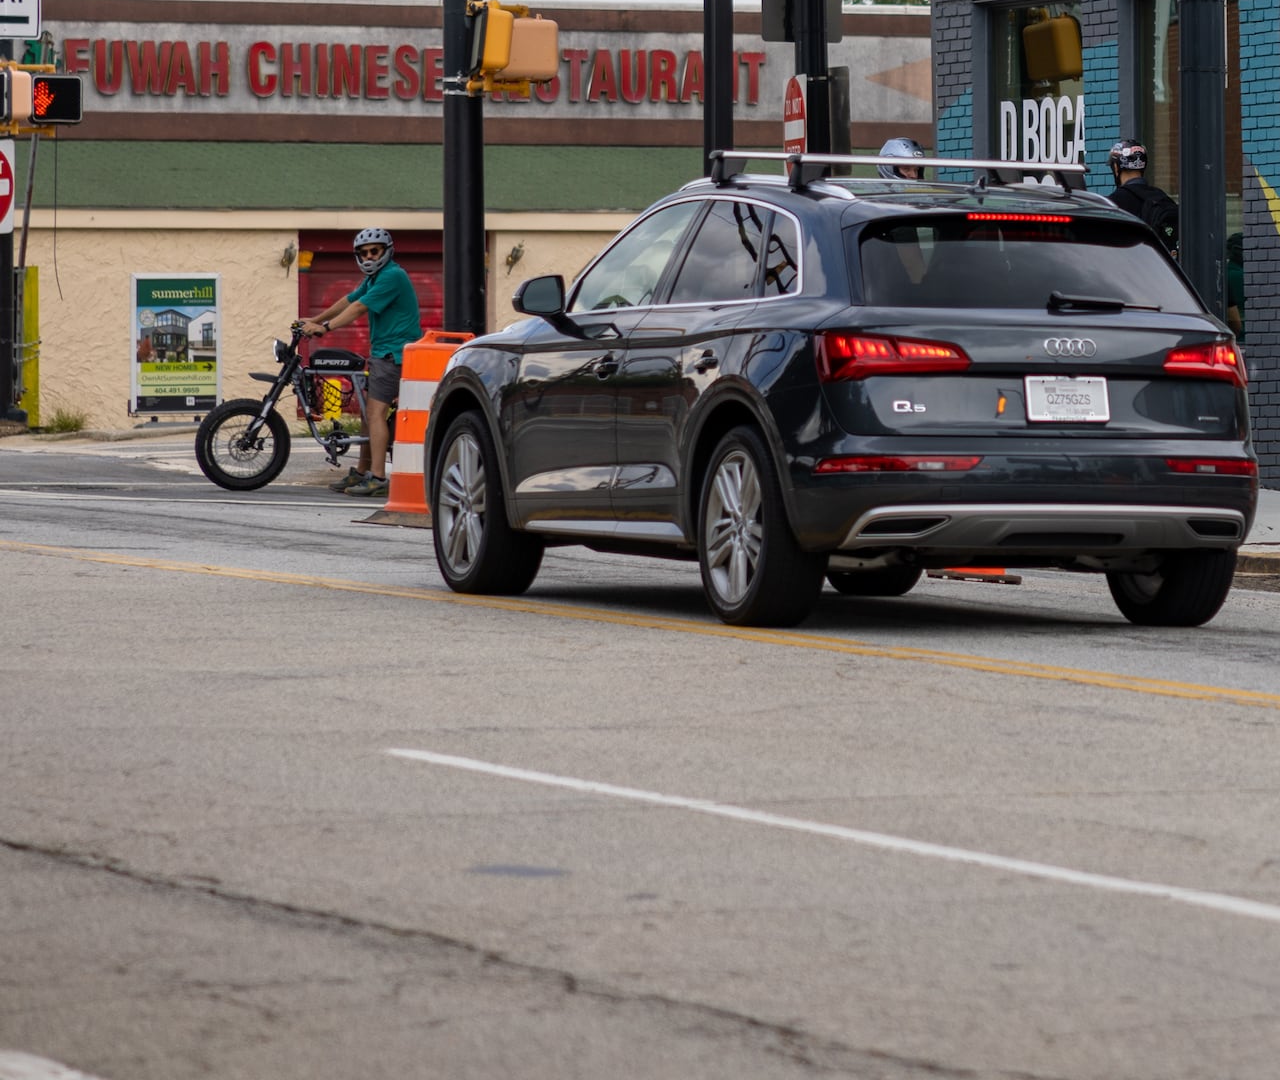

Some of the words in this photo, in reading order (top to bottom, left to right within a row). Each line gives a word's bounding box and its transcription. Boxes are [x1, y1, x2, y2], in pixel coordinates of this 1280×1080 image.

[64, 38, 229, 97] FUWAH
[248, 41, 444, 102] CHINESE
[491, 48, 766, 104] TAURAT
[1000, 100, 1018, 161] D
[1023, 94, 1086, 164] BOCA
[151, 286, 213, 299] summerhill
[893, 400, 927, 413] Q5
